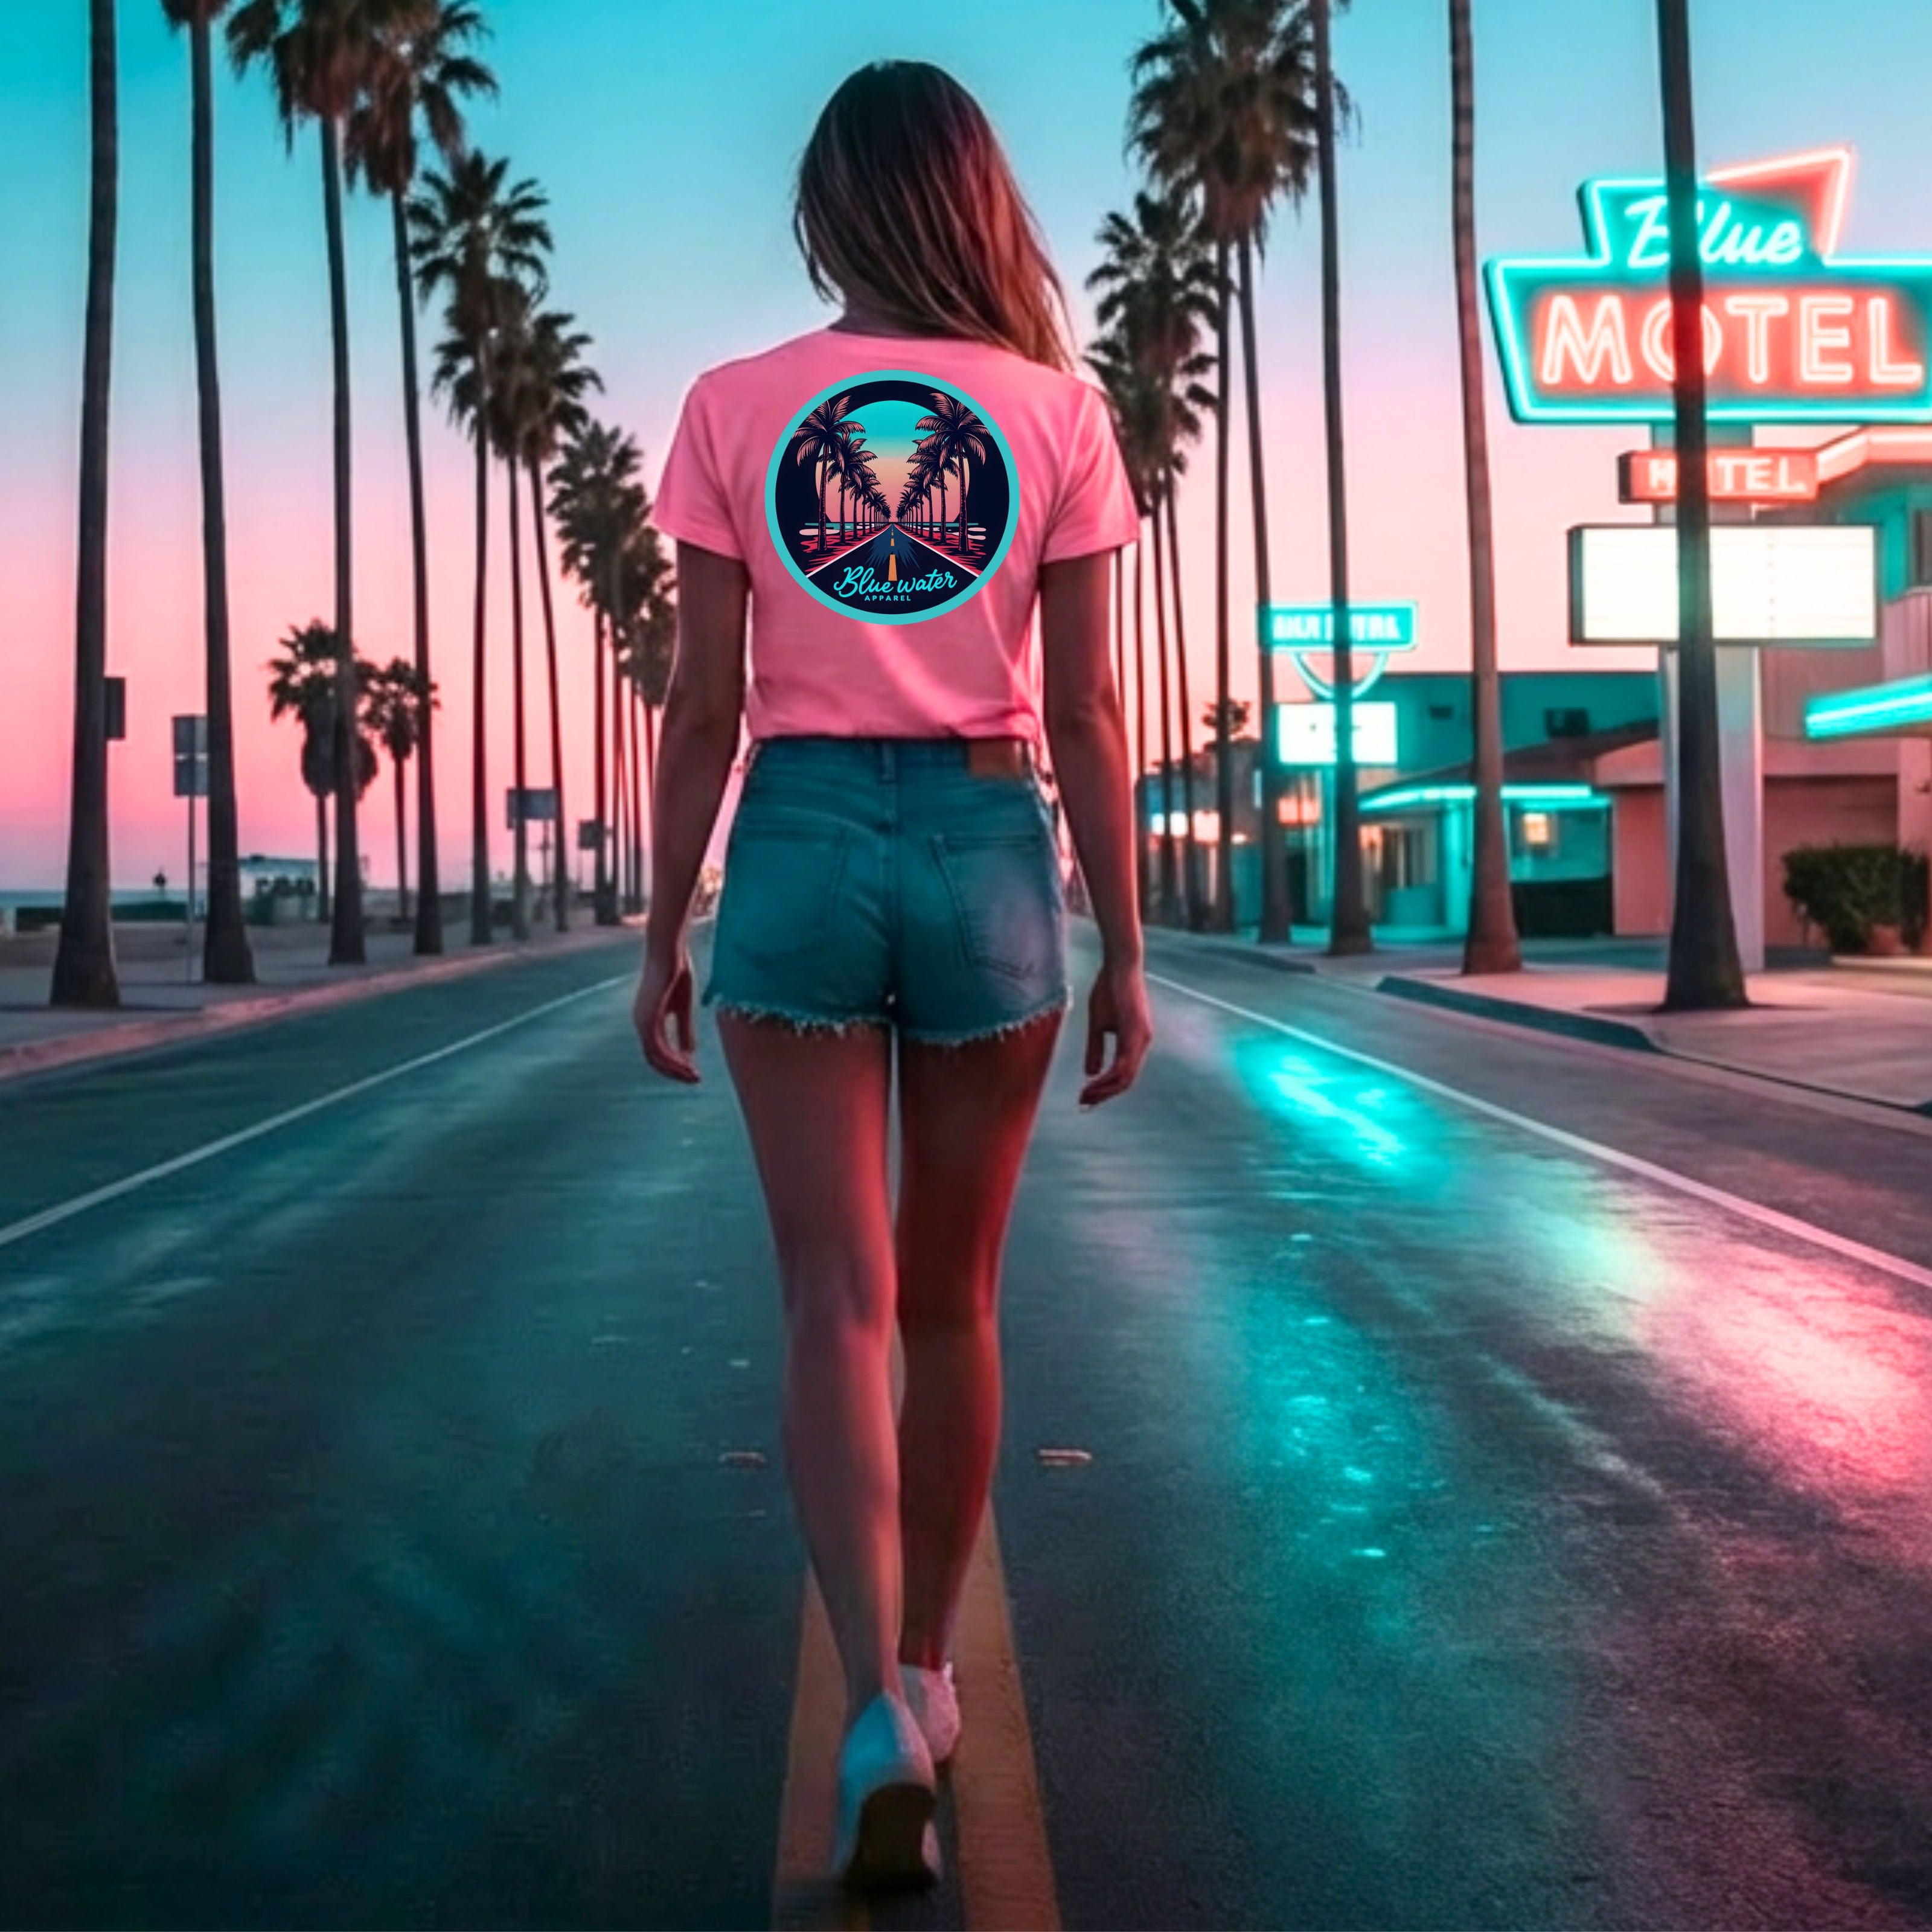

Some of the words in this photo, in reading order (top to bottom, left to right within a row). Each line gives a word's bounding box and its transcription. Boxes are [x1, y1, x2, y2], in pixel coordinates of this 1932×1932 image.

[1542, 295, 1924, 385] MOTEL
[833, 566, 894, 598] Blue
[897, 569, 958, 593] water
